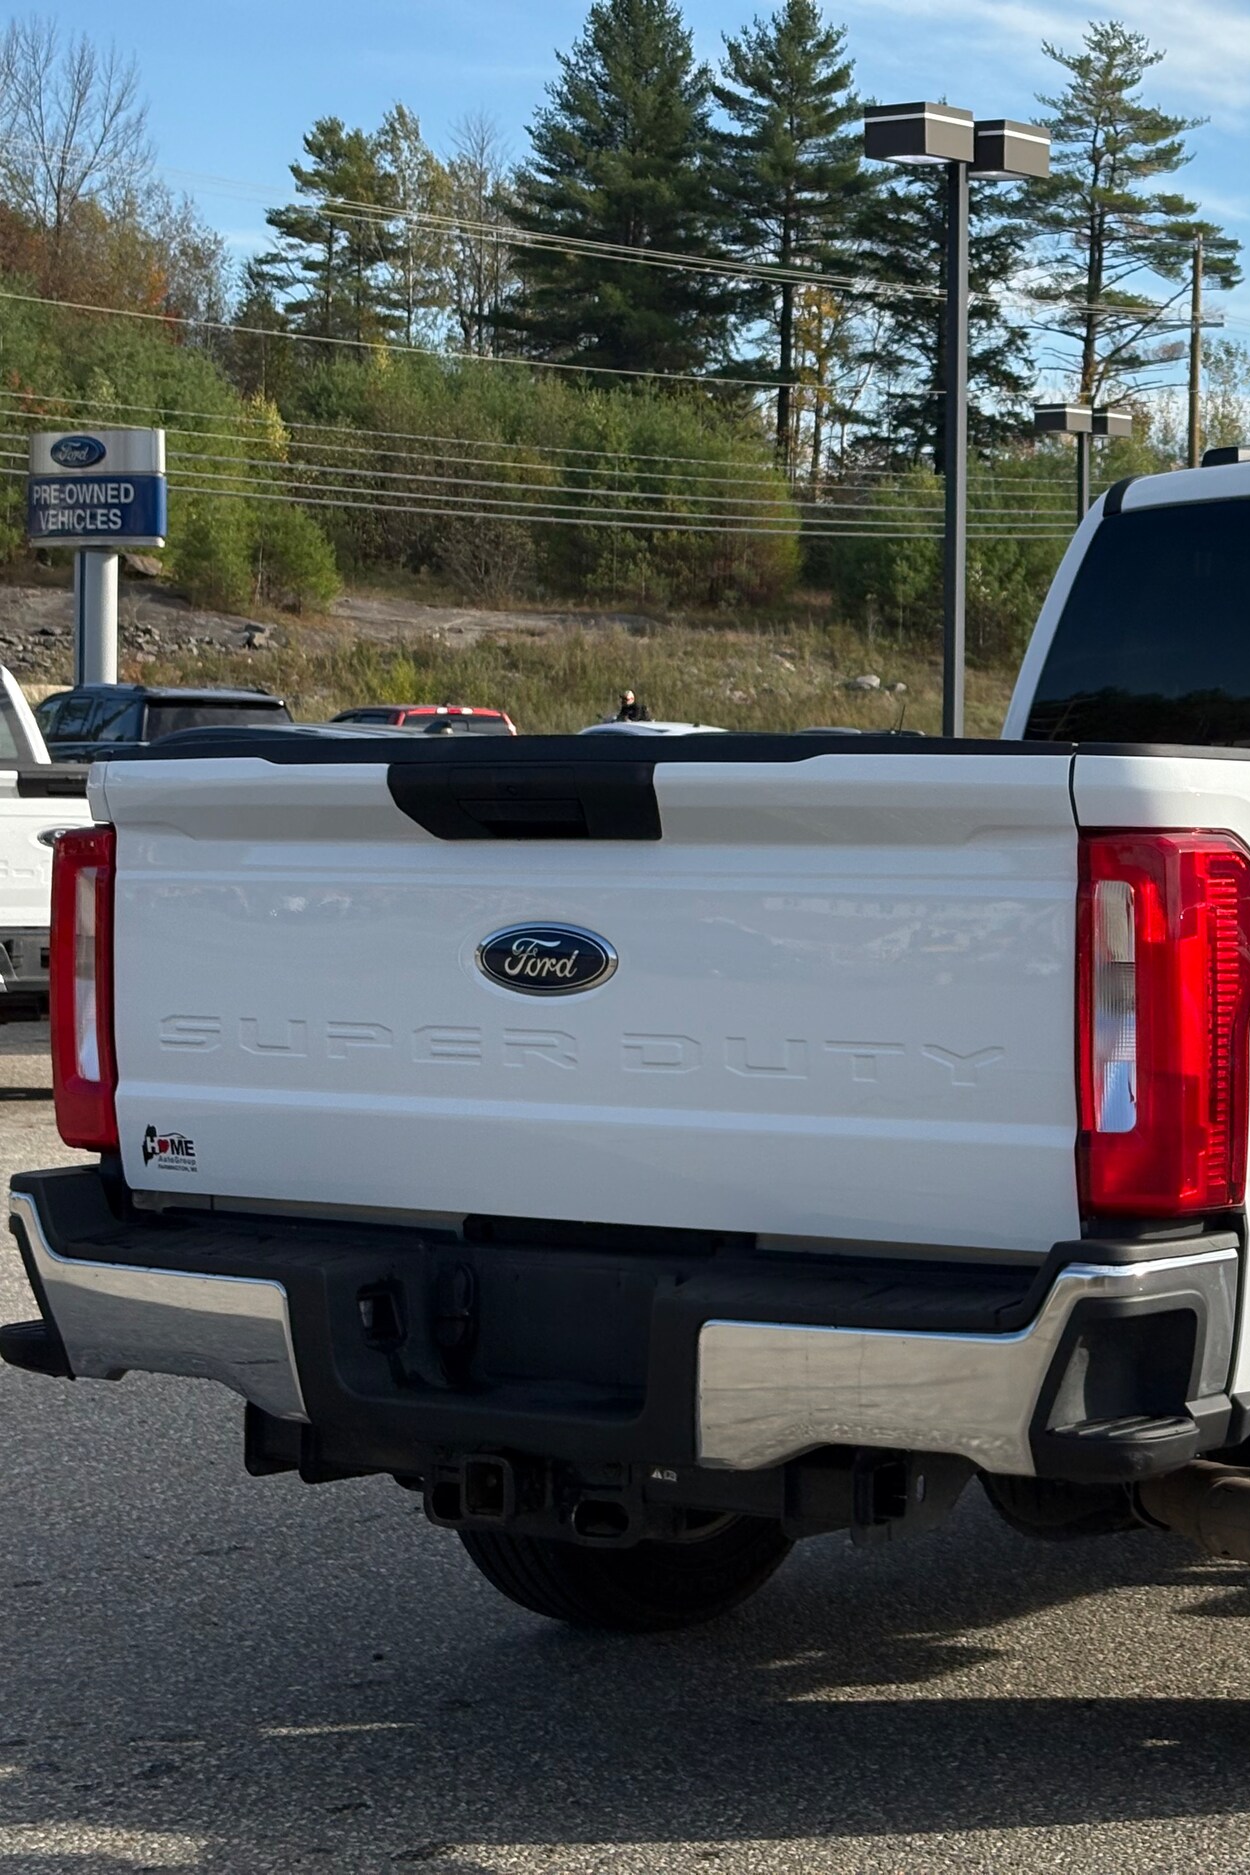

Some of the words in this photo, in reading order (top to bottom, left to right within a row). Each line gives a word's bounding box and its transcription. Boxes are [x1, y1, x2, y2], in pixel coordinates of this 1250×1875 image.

[58, 441, 89, 462] Ford
[33, 483, 135, 505] PRE-OWNED
[40, 509, 123, 530] VEHICLES
[504, 937, 580, 978] Ford
[160, 1014, 578, 1070] SUPER
[621, 1032, 1005, 1087] DUTY
